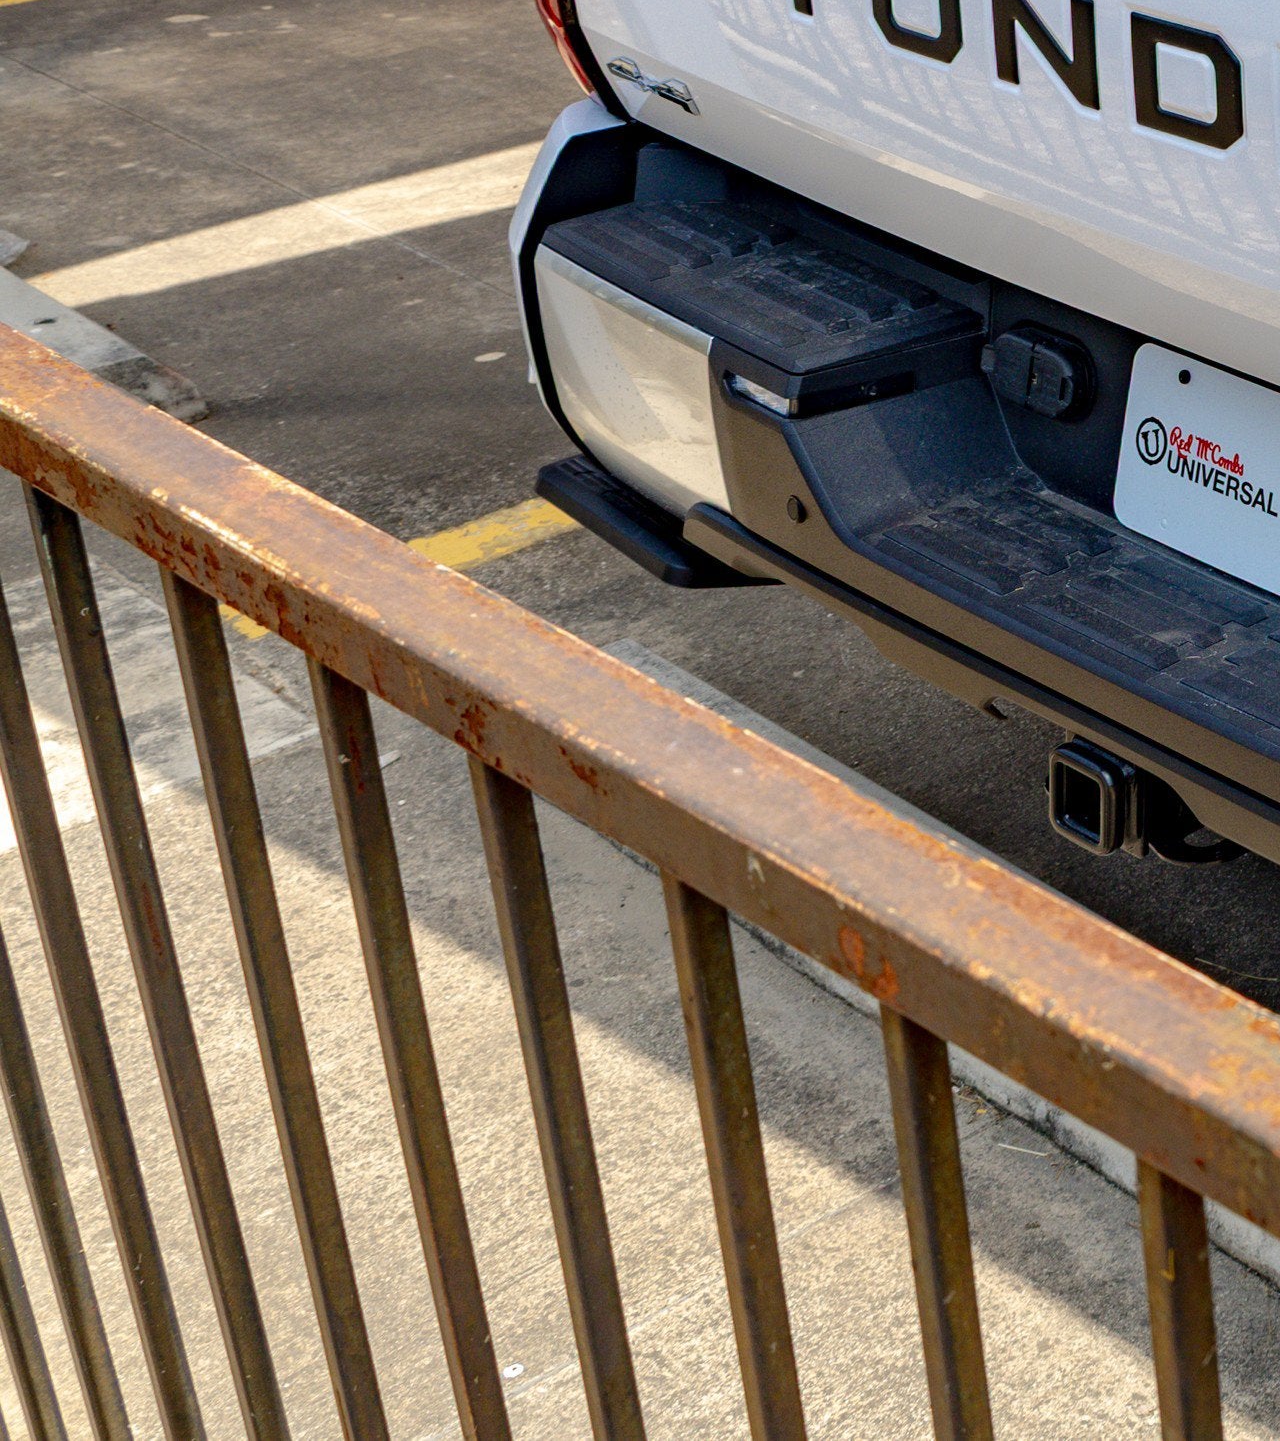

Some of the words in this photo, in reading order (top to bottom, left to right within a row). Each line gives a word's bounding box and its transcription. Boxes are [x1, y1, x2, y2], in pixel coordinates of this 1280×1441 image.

[1169, 426, 1194, 460] Red
[1195, 434, 1245, 477] McCombs
[1166, 449, 1279, 518] UNIVERSAL
